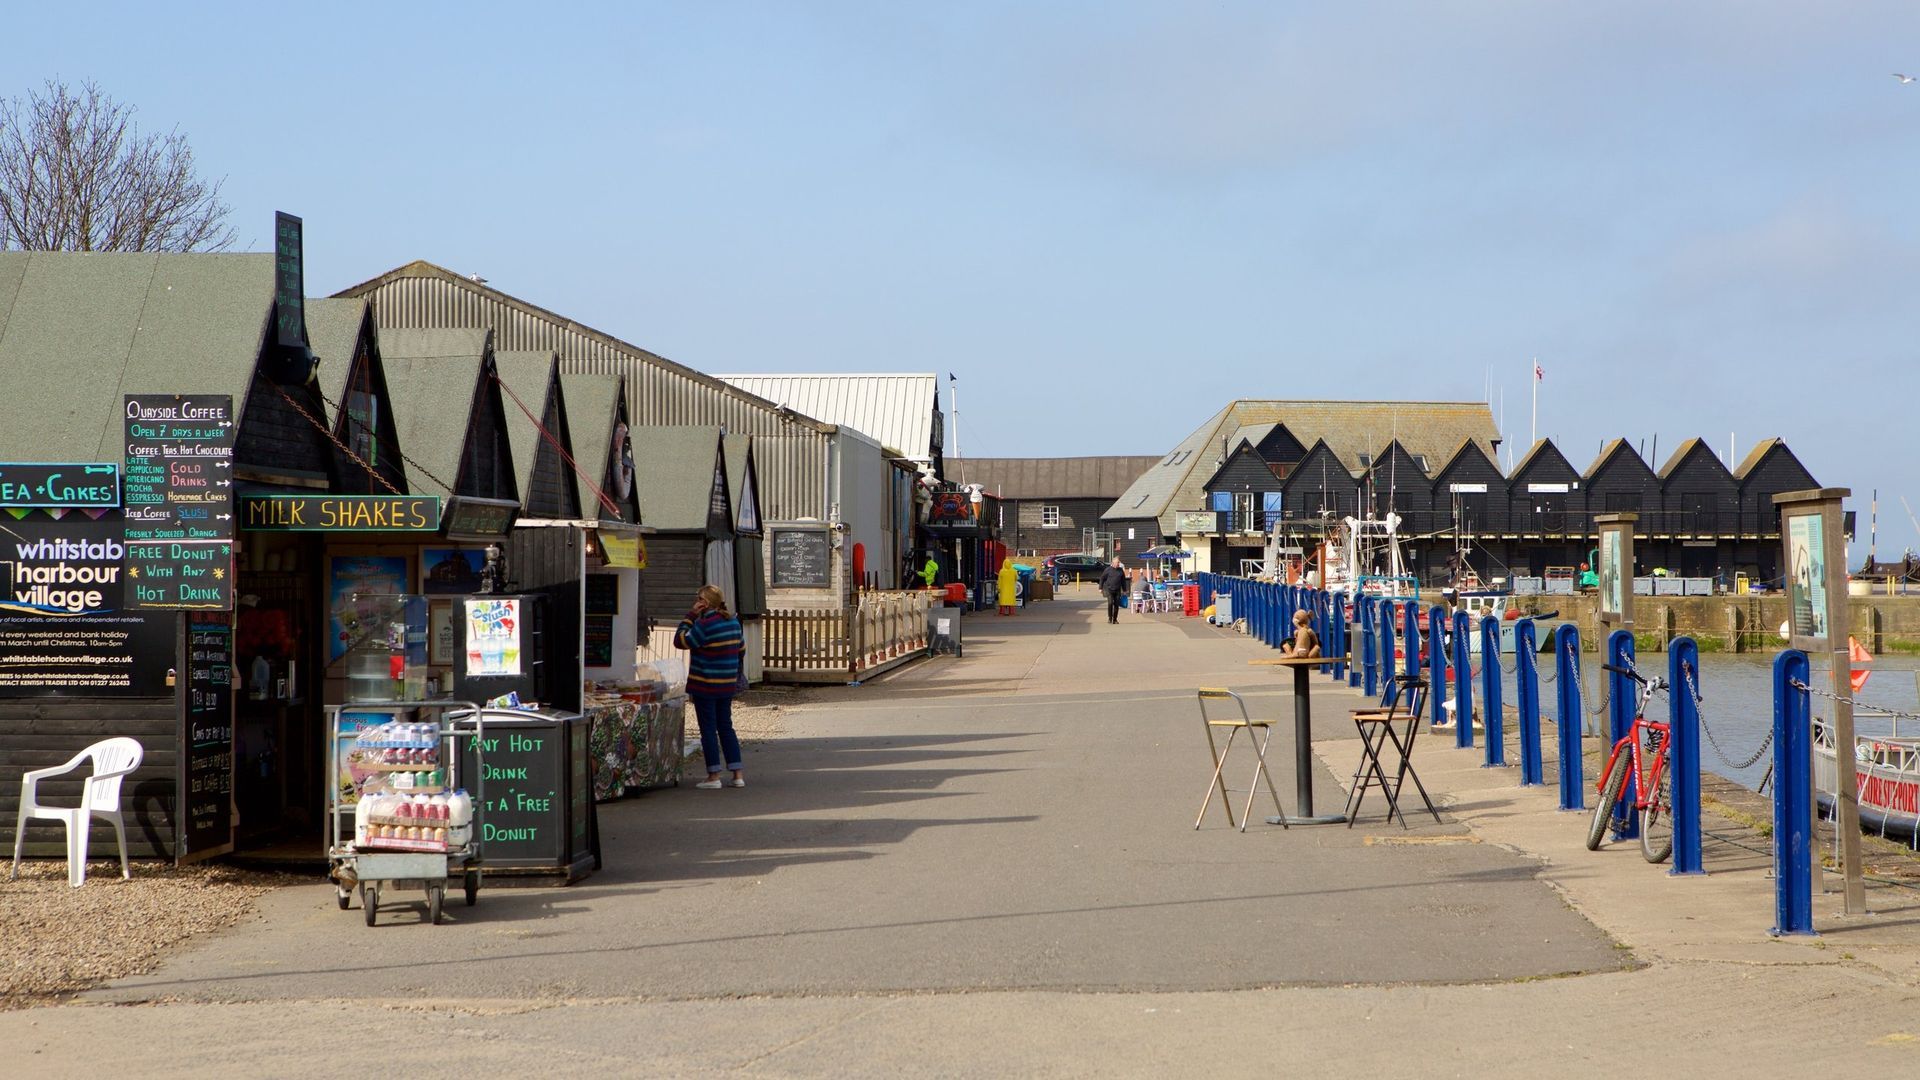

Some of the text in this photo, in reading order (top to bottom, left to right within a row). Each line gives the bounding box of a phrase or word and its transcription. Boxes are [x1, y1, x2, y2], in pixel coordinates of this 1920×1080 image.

[127, 401, 177, 418] QUAYSIDE
[131, 424, 155, 437] OPEN
[160, 425, 166, 436] 7
[180, 445, 193, 455] HOT
[195, 444, 233, 455] CHOCOLATE
[170, 462, 201, 473] COLD
[0, 472, 31, 500] EA
[47, 474, 112, 501] CAKES
[171, 475, 206, 486] DRINKS
[168, 491, 227, 501] HOMEMADE CAKES
[124, 507, 171, 518] ICED COFFEE
[177, 506, 208, 517] SLUSH
[250, 500, 305, 525] MILK
[320, 501, 426, 528] SHAKES
[125, 527, 217, 538] FRESHLY SQUEEZED ORANGE
[129, 544, 215, 560] FREE DONUT
[17, 562, 120, 583] harbour
[146, 564, 206, 576] WITH ANY
[16, 585, 102, 612] village
[137, 584, 220, 600] HOT DRINK
[468, 734, 544, 752] ANY HOT
[482, 764, 527, 780] DRINK
[499, 798, 508, 811] A
[1884, 779, 1918, 814] SUPPORT
[483, 824, 537, 841] DONUT
